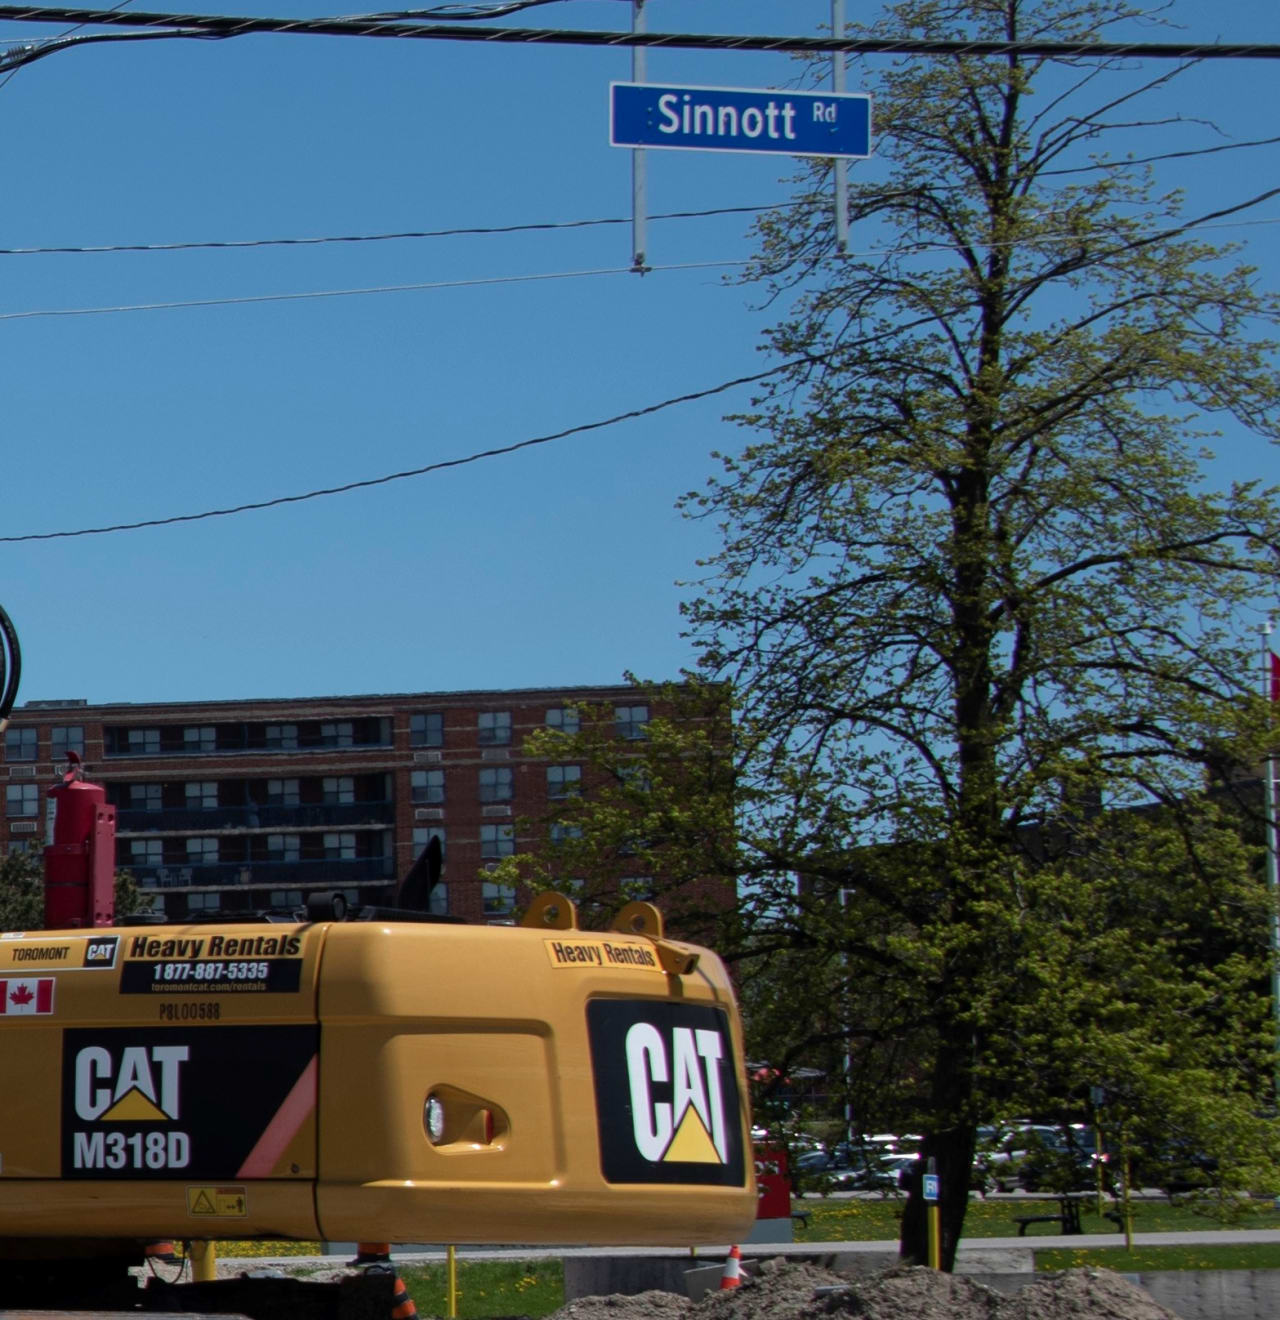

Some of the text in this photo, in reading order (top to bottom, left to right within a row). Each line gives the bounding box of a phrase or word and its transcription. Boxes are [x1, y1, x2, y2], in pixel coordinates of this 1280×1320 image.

[658, 93, 837, 140] Sinnott Rd
[12, 943, 115, 962] TOROMONT CAT
[130, 935, 301, 959] Heavy Rentals
[552, 942, 656, 967] Heavy Rentals
[164, 962, 269, 979] 877-887-5335
[151, 981, 267, 993] toromontcat.com/rentals
[75, 1046, 190, 1121] CAT
[625, 1022, 729, 1164] CAT
[73, 1131, 191, 1169] M318D
